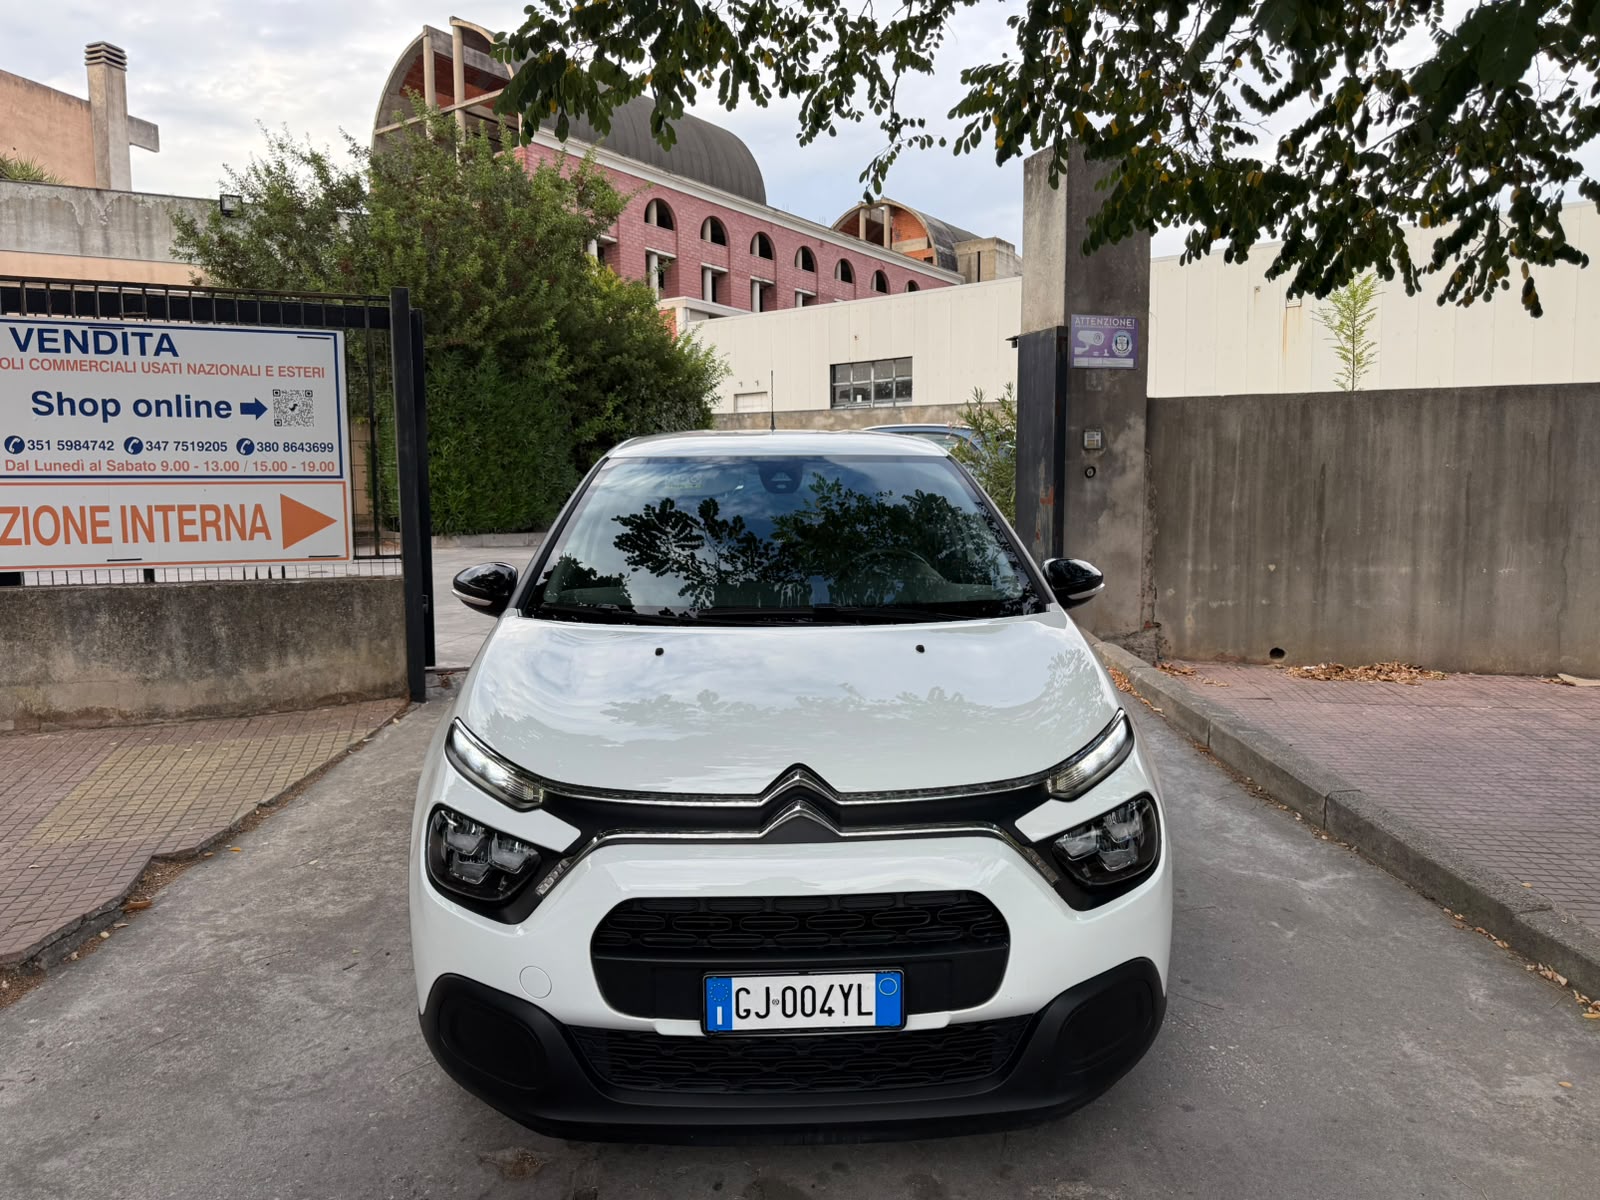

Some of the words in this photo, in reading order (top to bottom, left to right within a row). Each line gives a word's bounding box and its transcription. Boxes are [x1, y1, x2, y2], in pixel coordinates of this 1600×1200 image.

[1075, 317, 1135, 327] ATTENZIONE!
[9, 327, 179, 357] VENDITA
[29, 358, 137, 374] COMMERCIALI
[141, 362, 182, 375] USATI
[187, 363, 261, 377] NAZIONALI
[265, 366, 274, 377] E
[278, 366, 325, 379] ESTERI
[31, 390, 121, 423] Shop
[132, 394, 233, 418] online
[27, 440, 51, 451] 351
[57, 440, 115, 451] 5984742
[145, 441, 169, 452] 347
[174, 441, 228, 452] 7519205
[256, 442, 279, 453] 380
[282, 442, 334, 453] 8643699
[5, 460, 30, 472] Dal
[34, 459, 85, 472] Lunedì
[89, 460, 102, 472] al
[106, 460, 157, 472] Sabato
[160, 461, 190, 472] 9.00
[204, 461, 240, 472] 13.00
[252, 461, 288, 472] 15.00
[300, 461, 335, 472] 19.00
[0, 505, 113, 546] ZIONE
[120, 504, 272, 543] INTERNA
